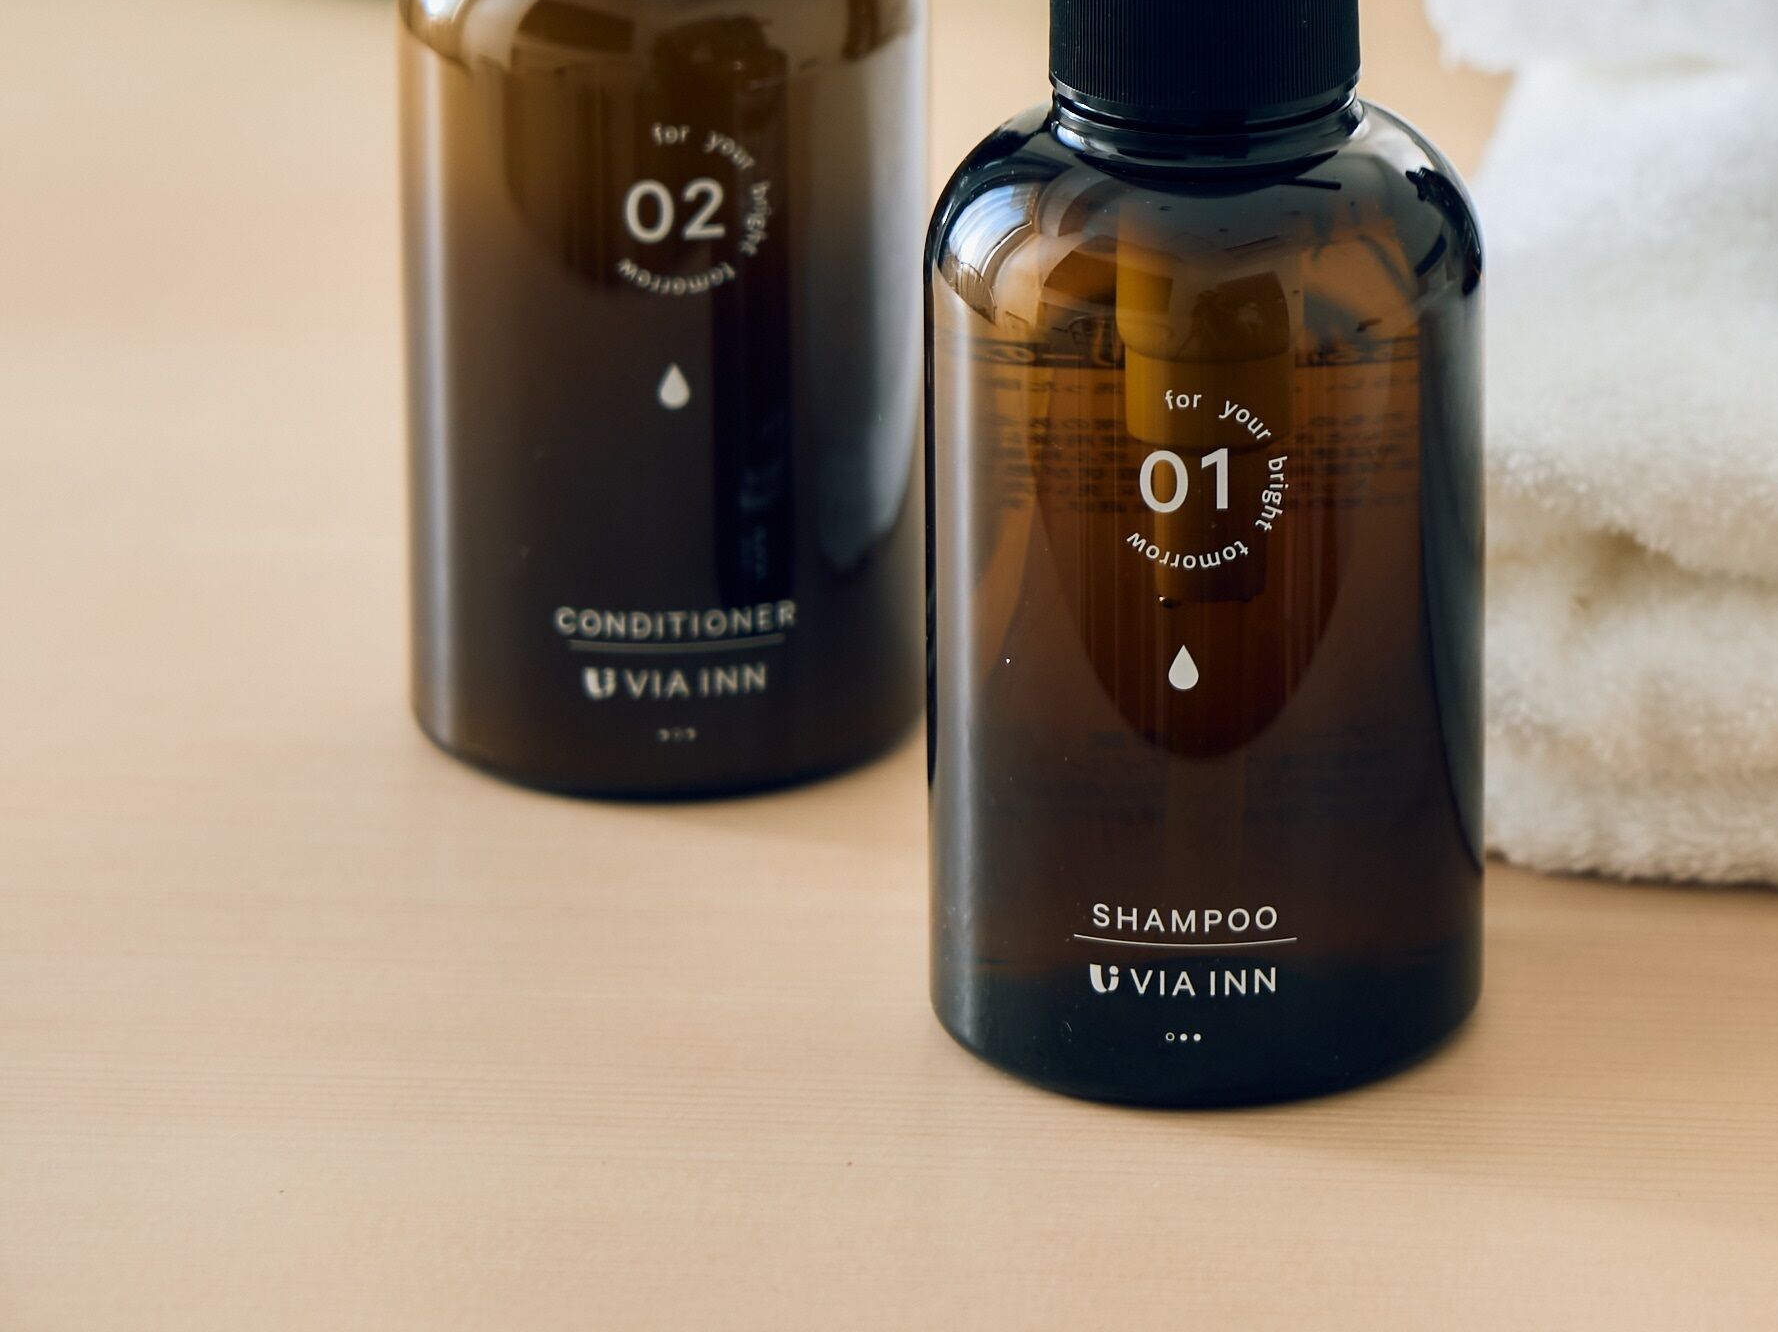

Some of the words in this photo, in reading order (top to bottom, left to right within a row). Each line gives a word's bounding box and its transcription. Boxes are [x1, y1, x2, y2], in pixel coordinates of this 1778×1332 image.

[652, 122, 690, 145] for
[705, 131, 755, 170] your
[624, 177, 726, 244] 02
[1164, 389, 1202, 410] for
[1218, 400, 1272, 440] your
[1139, 447, 1229, 513] 01
[1255, 455, 1289, 532] bright
[1126, 532, 1250, 569] tomorrow
[554, 600, 797, 640] CONDITIONER
[624, 668, 691, 699] VIA
[699, 662, 768, 697] INN
[1092, 903, 1278, 933] SHAMPOO
[1130, 968, 1196, 997] VIA
[1209, 967, 1277, 997] INN
